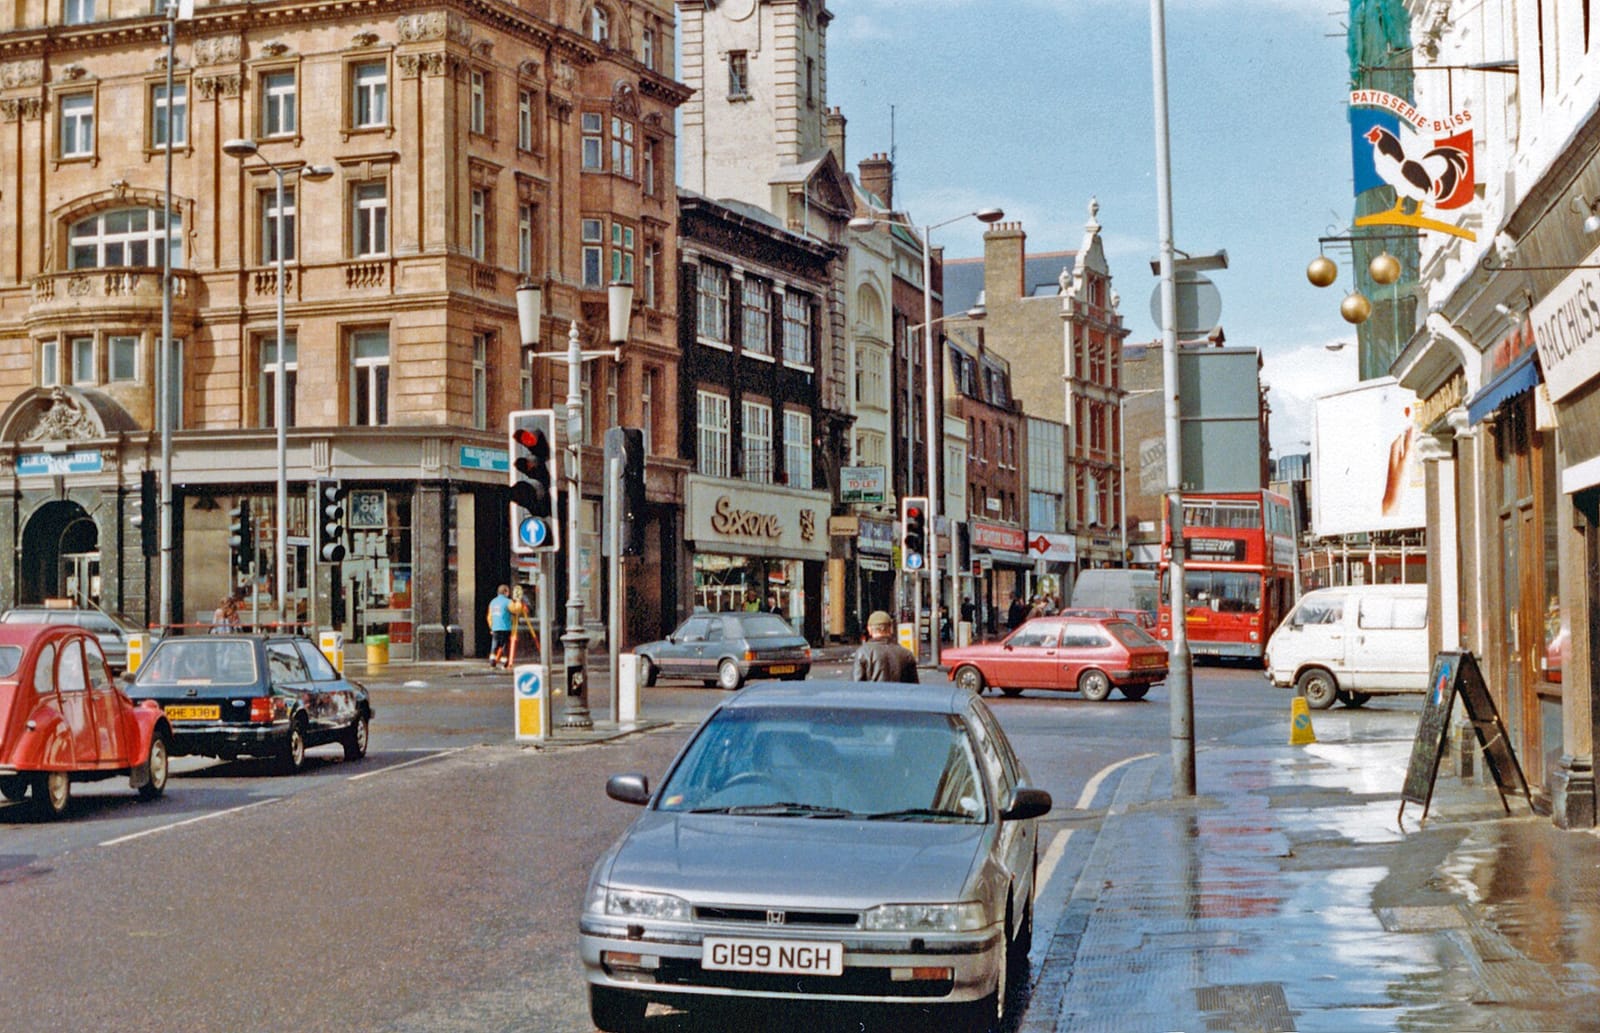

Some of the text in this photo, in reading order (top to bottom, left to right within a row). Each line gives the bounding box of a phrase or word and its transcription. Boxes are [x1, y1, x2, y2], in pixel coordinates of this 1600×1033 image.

[1352, 91, 1472, 132] PATISSERIE BLISS
[848, 480, 878, 489] TO LET
[712, 943, 831, 970] G199 NGH
